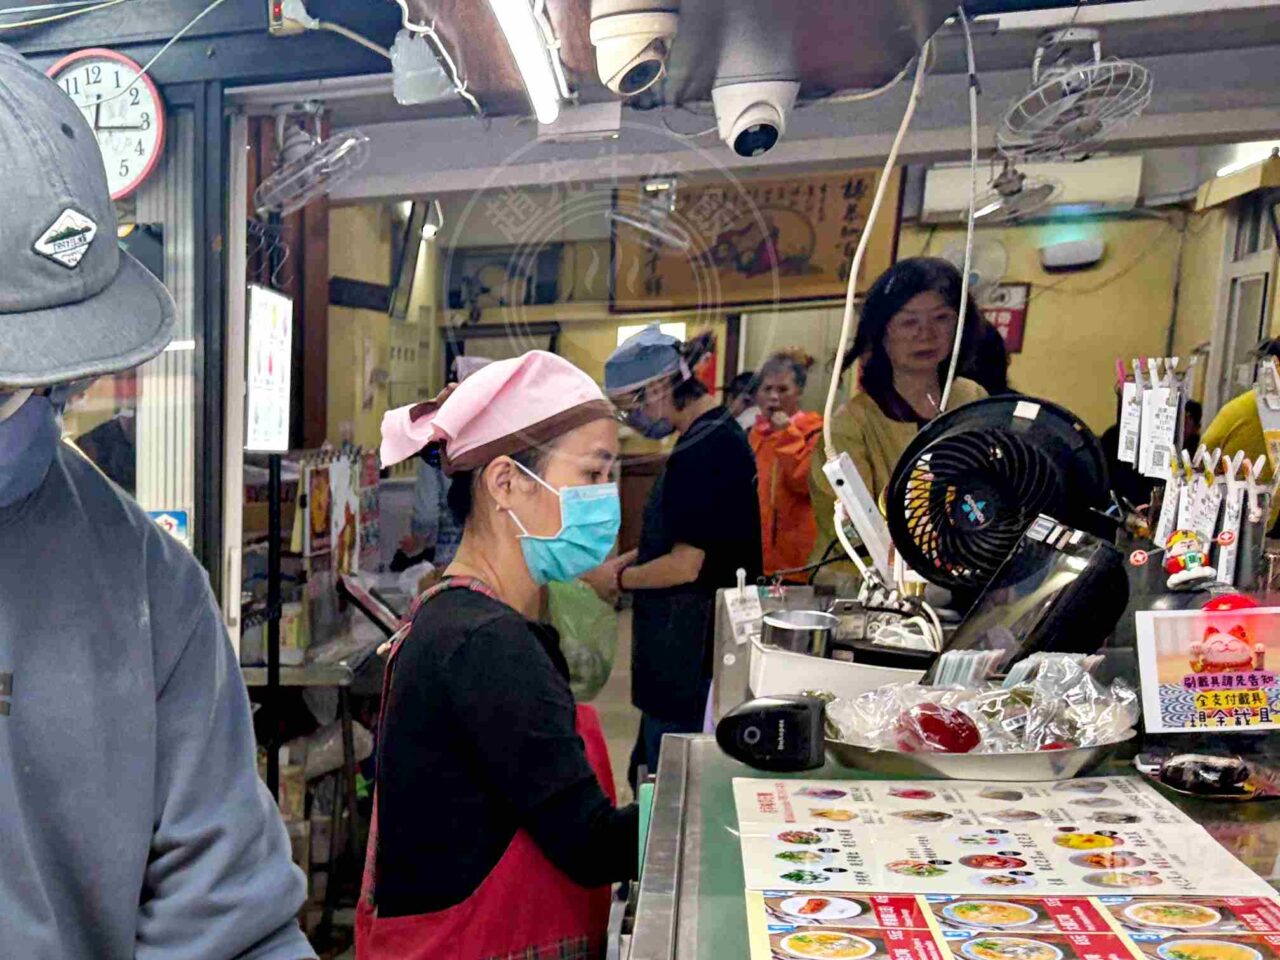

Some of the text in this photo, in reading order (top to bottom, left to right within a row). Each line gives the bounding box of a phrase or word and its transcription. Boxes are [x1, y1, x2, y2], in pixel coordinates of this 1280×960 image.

[85, 66, 102, 85] 12
[114, 71, 121, 88] 1
[65, 77, 79, 95] 11
[130, 88, 140, 105] 2
[140, 112, 150, 130] 3
[135, 139, 144, 156] 4
[119, 160, 129, 177] 5
